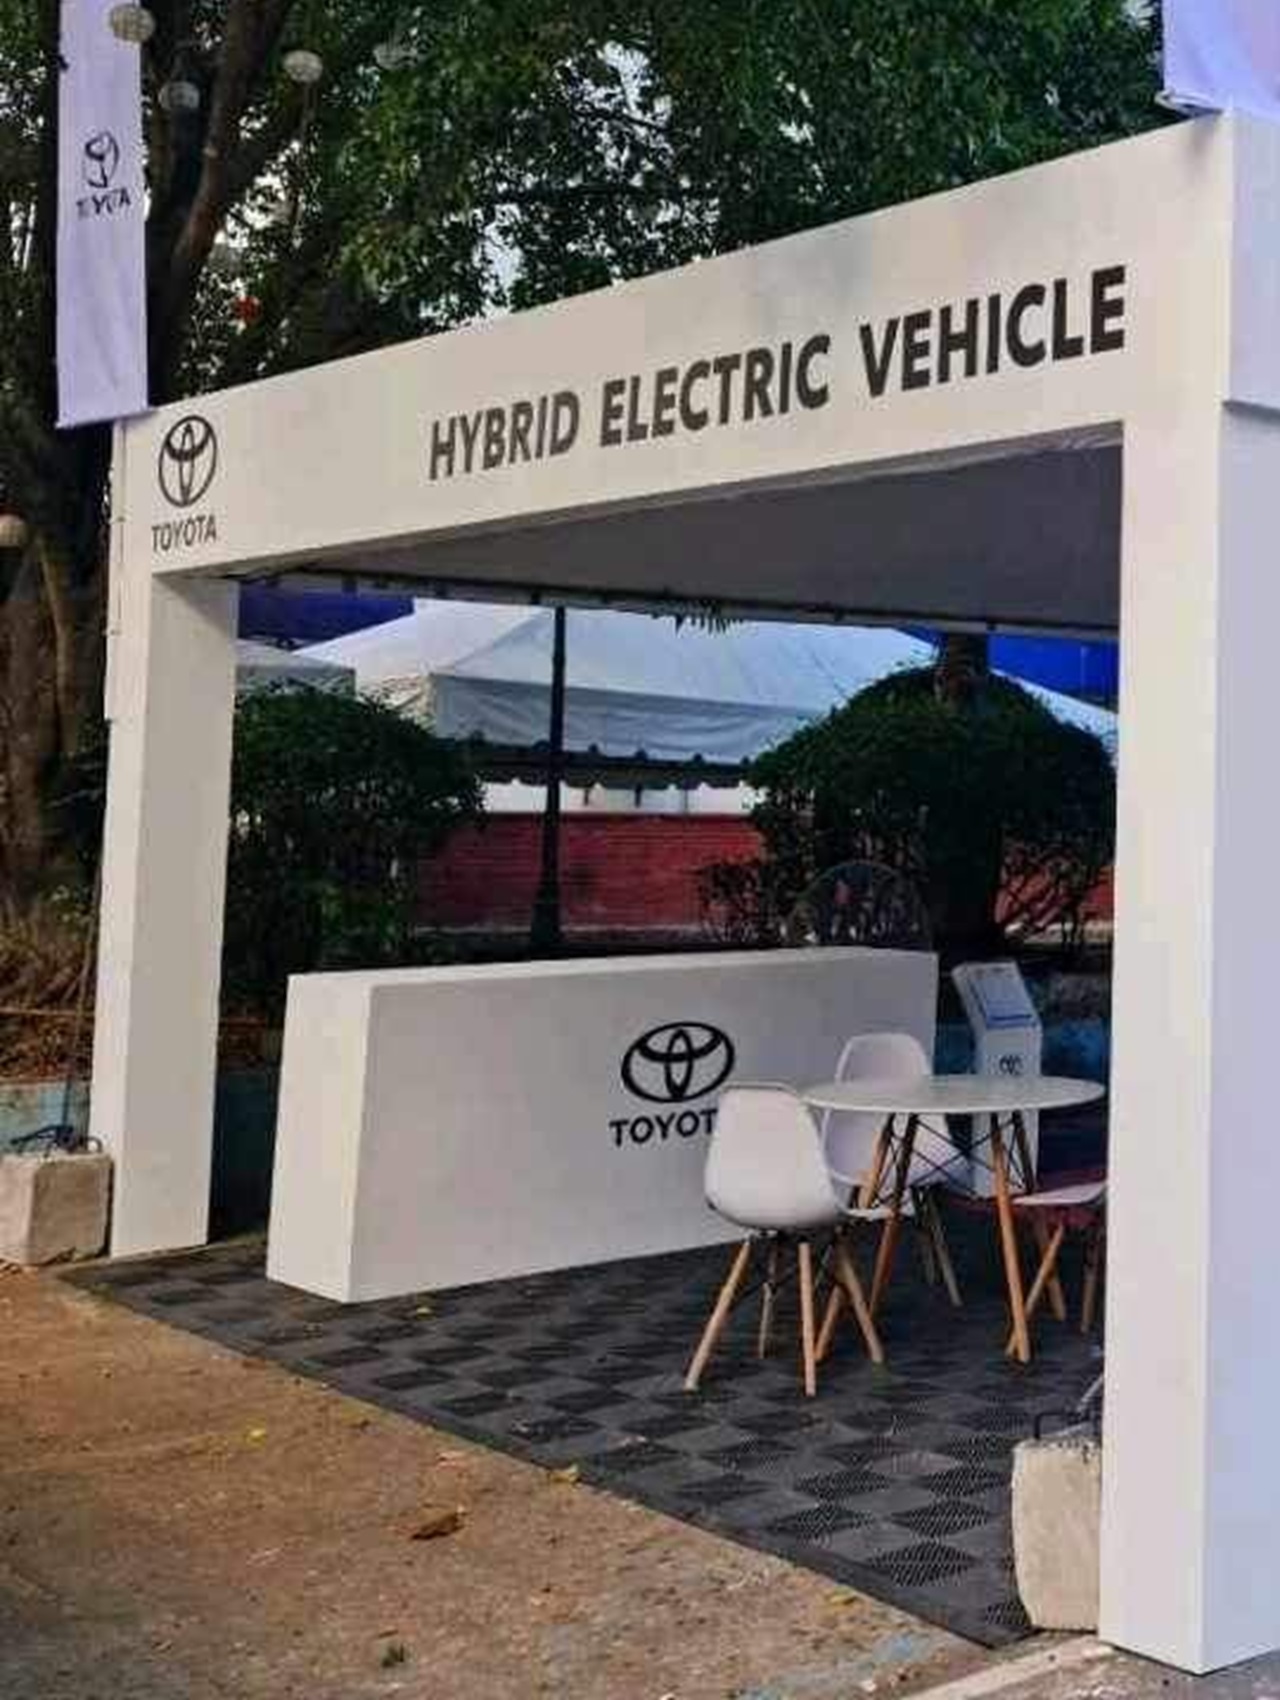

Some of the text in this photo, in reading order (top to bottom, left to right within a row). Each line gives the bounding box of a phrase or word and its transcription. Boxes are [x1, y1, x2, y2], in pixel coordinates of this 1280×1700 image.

[429, 264, 1127, 481] HYBRID ELECTRIC VEHICLE
[151, 514, 217, 553] TOYOTA
[608, 1107, 719, 1148] TOYOT
